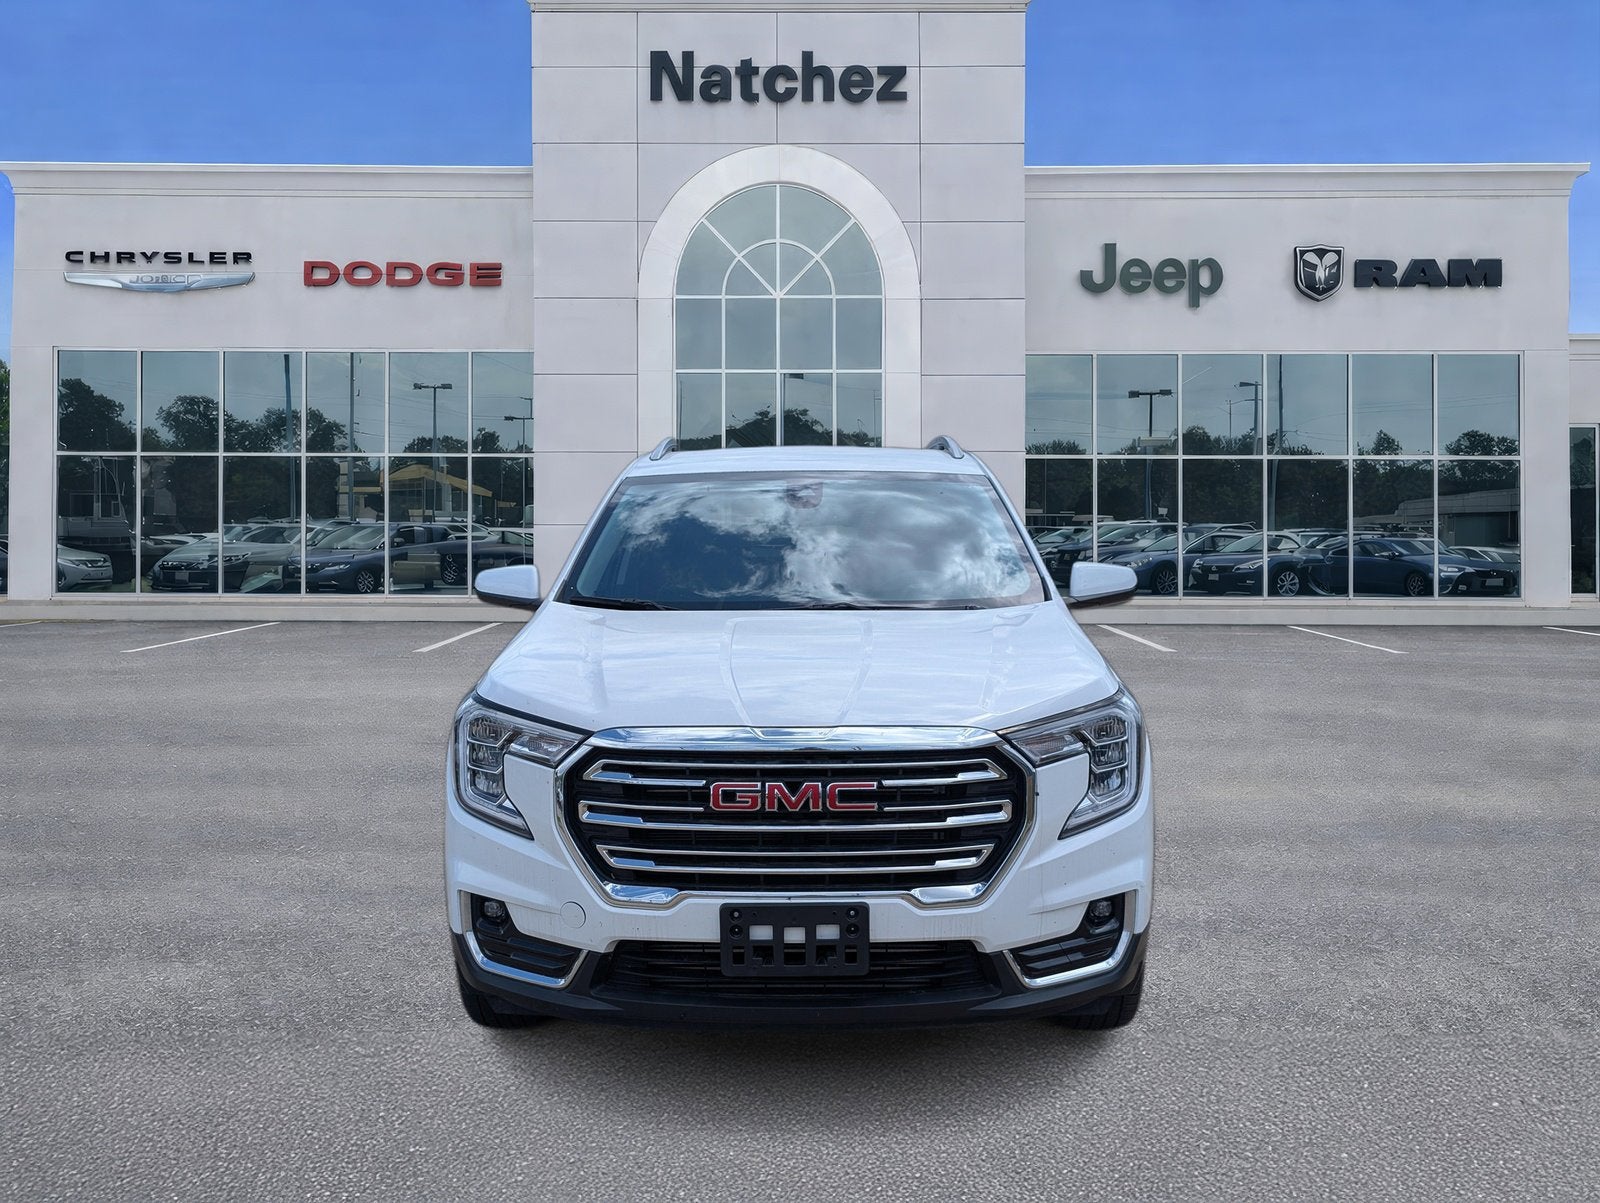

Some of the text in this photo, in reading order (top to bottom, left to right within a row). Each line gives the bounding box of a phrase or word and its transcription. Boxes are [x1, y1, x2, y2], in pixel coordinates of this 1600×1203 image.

[650, 50, 908, 102] Natchez
[65, 250, 253, 265] CHRYSLER
[304, 260, 502, 288] DODGE
[1080, 243, 1223, 309] Jeep
[1354, 259, 1503, 288] RAM
[710, 782, 878, 812] GMC
